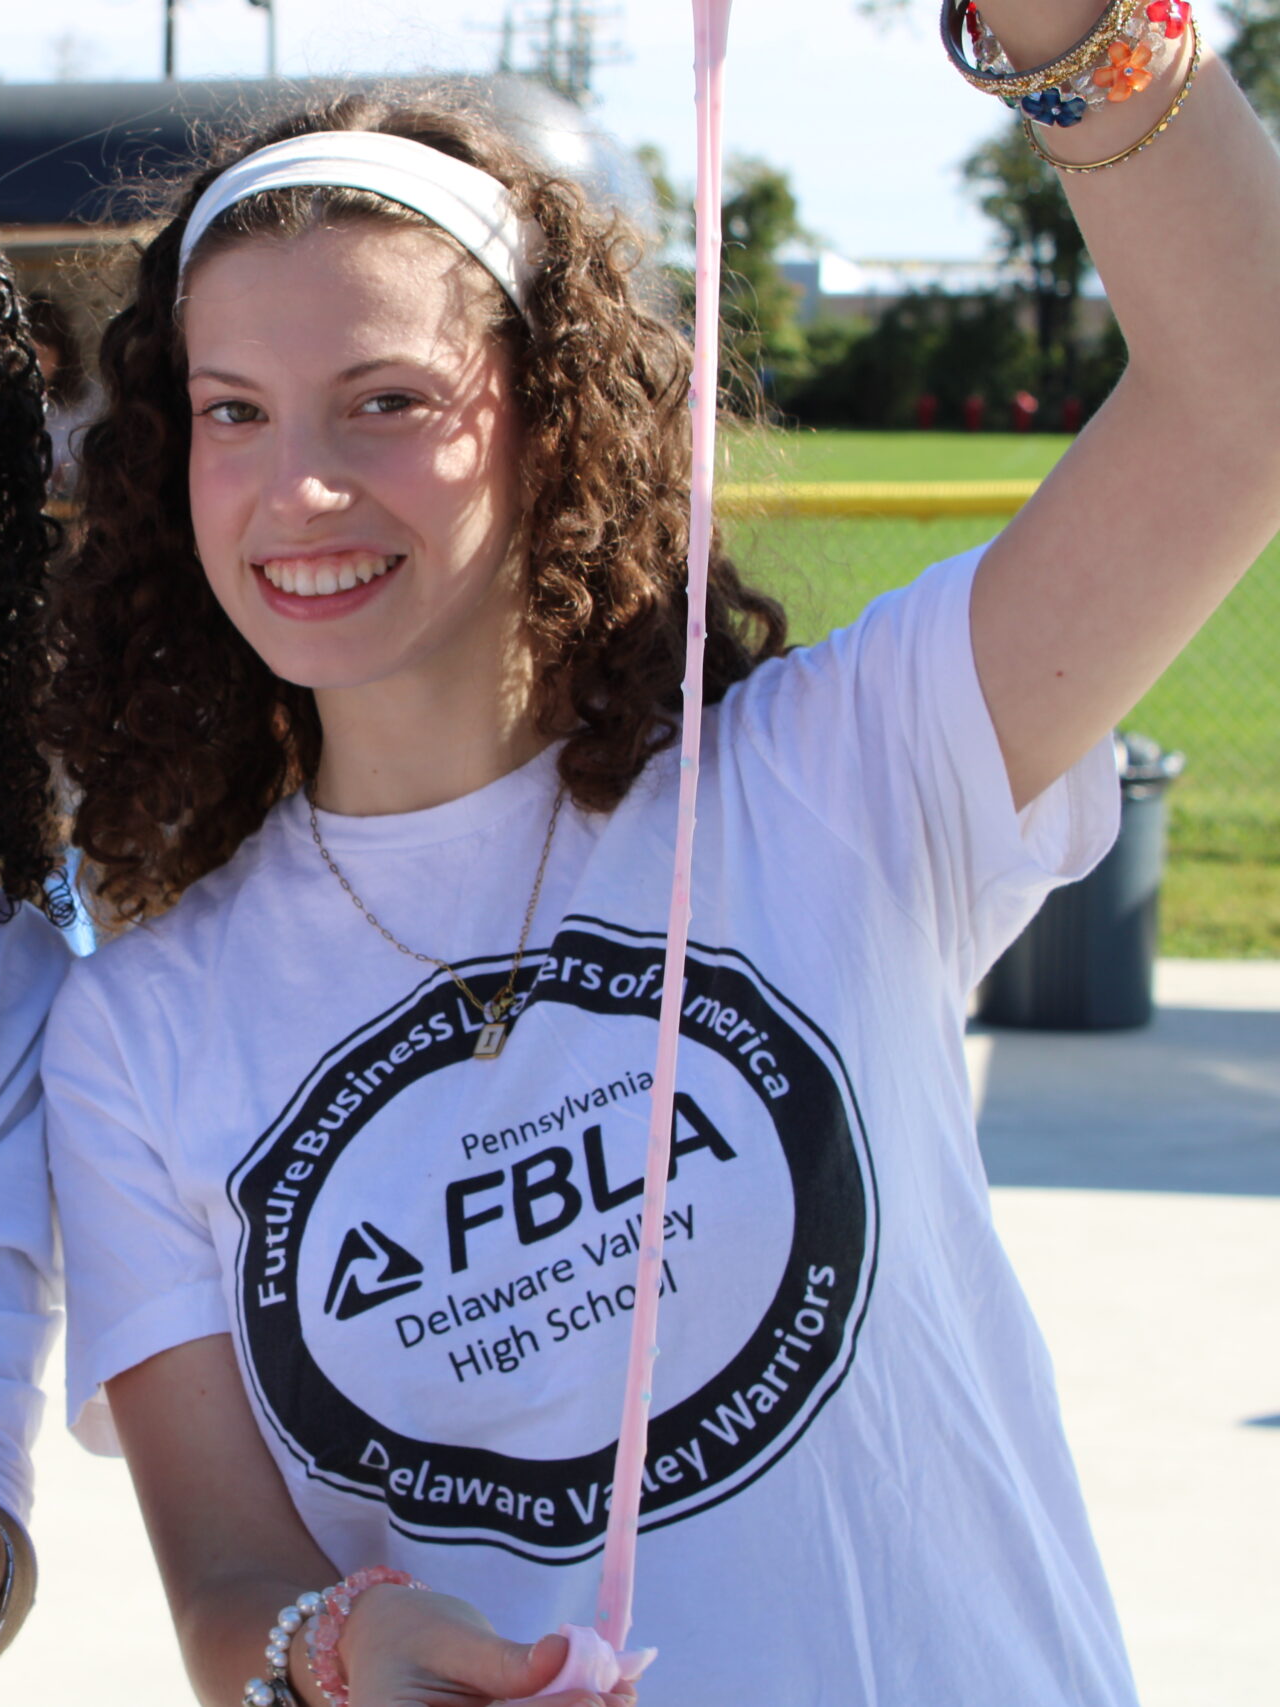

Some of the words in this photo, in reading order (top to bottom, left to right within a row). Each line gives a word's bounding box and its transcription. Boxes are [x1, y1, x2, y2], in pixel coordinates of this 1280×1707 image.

[257, 1160, 315, 1308] Future
[292, 1011, 455, 1157] Business
[457, 955, 604, 1034] Laers
[608, 963, 663, 999] of
[445, 1091, 738, 1274] FBLA
[461, 1069, 655, 1161] Pennsylvania
[394, 1257, 576, 1349] Delaware
[582, 1203, 694, 1267] Valey
[447, 1325, 541, 1383] High
[546, 1259, 678, 1342] Schol
[359, 1439, 556, 1528] Delaware
[566, 1437, 709, 1526] Vley
[699, 1263, 836, 1447] Warriors
